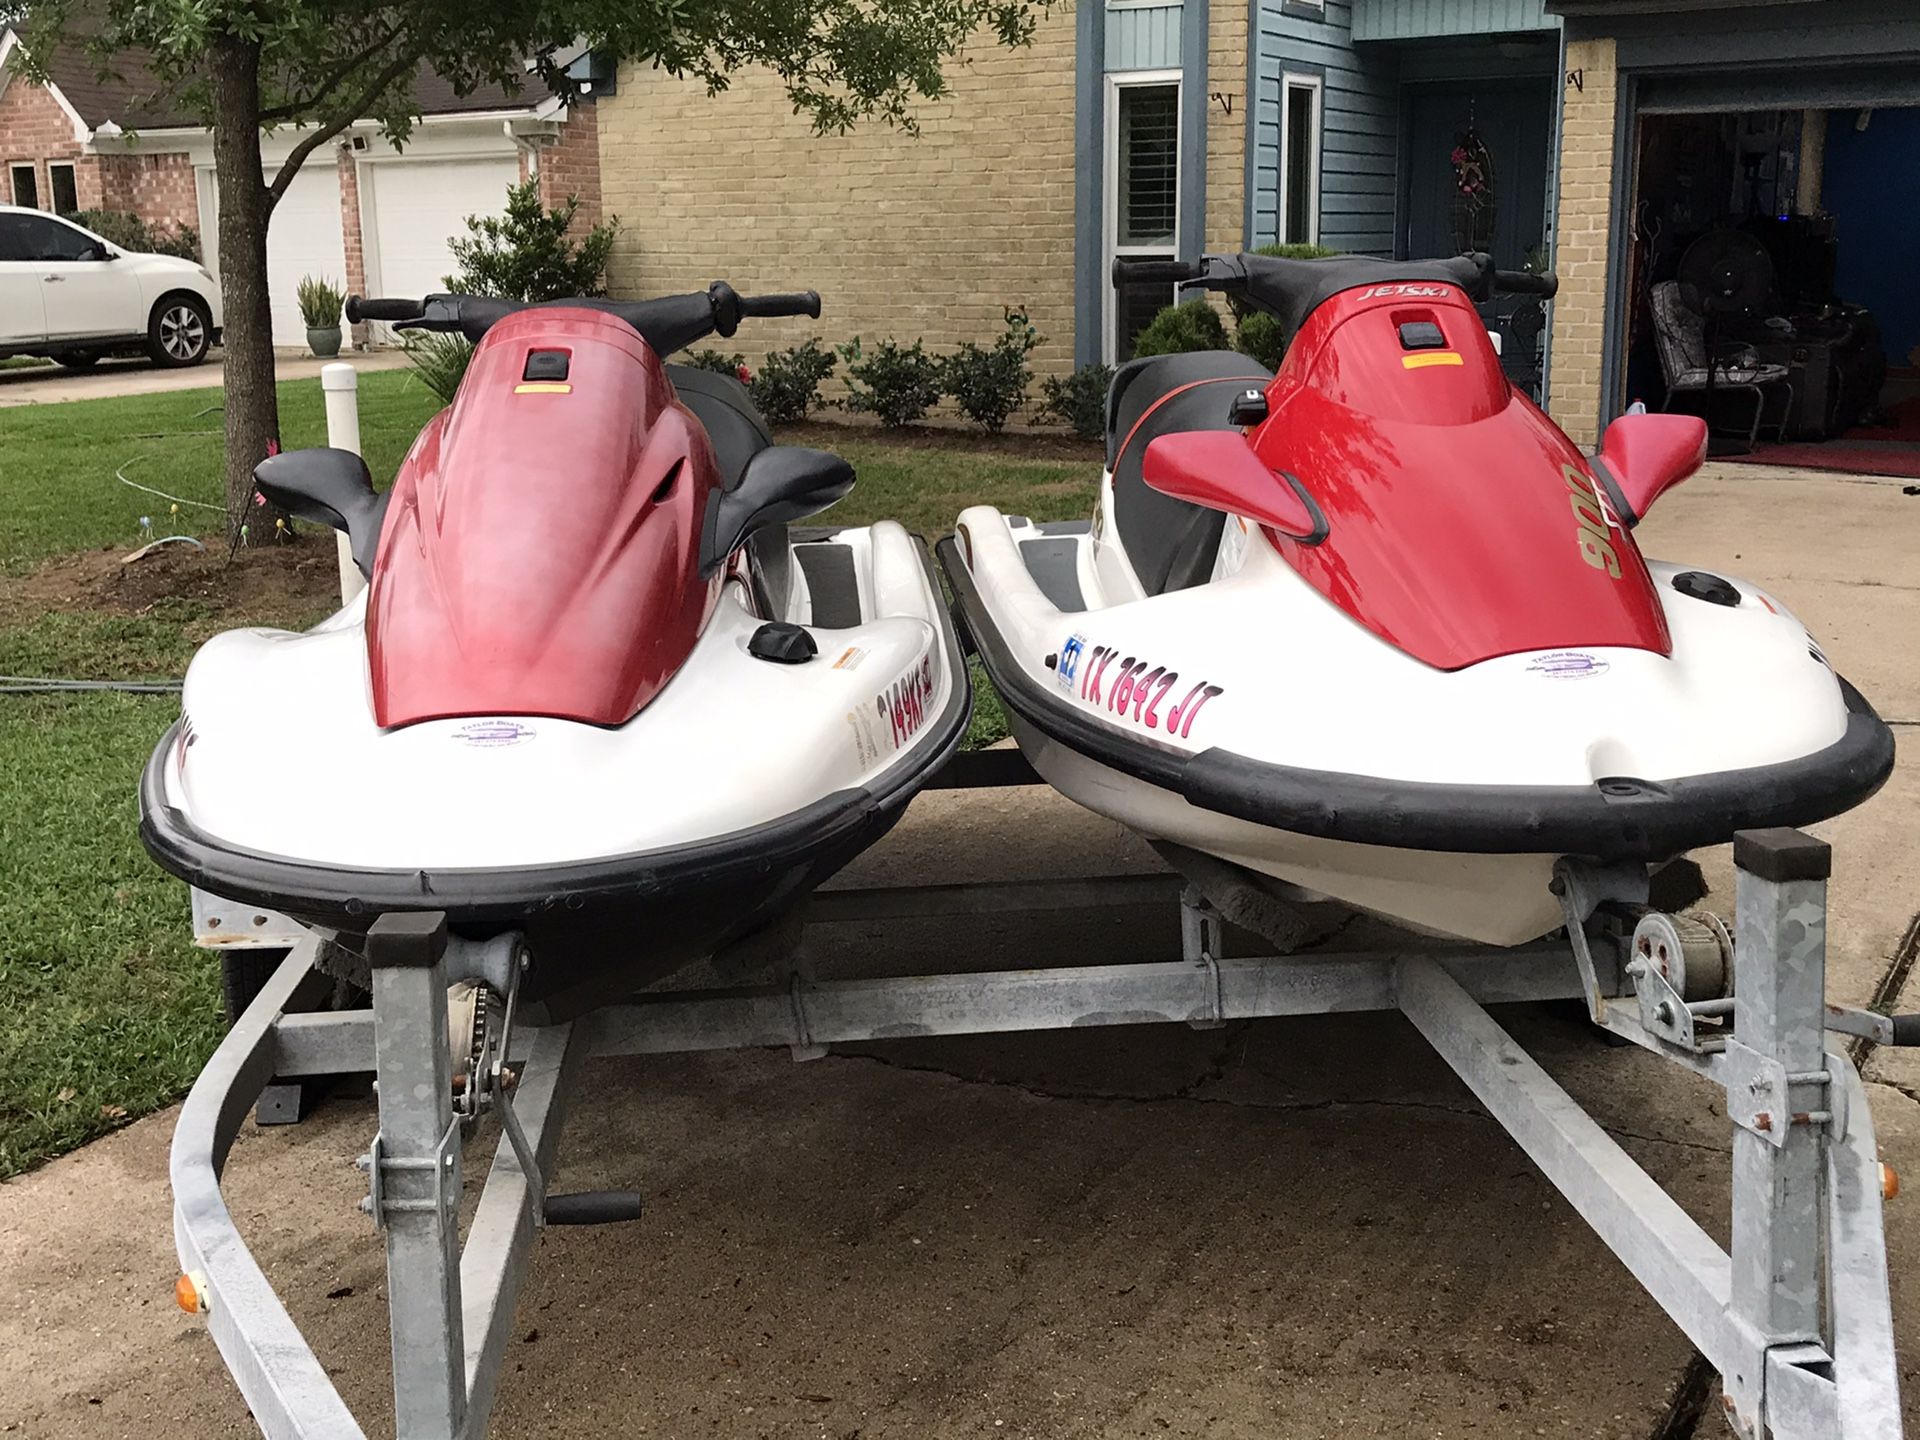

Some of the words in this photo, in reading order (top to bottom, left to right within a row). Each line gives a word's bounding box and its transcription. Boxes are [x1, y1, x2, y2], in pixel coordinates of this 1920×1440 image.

[1561, 463, 1622, 579] 900
[1081, 645, 1119, 705] TX
[1166, 680, 1224, 738] JT
